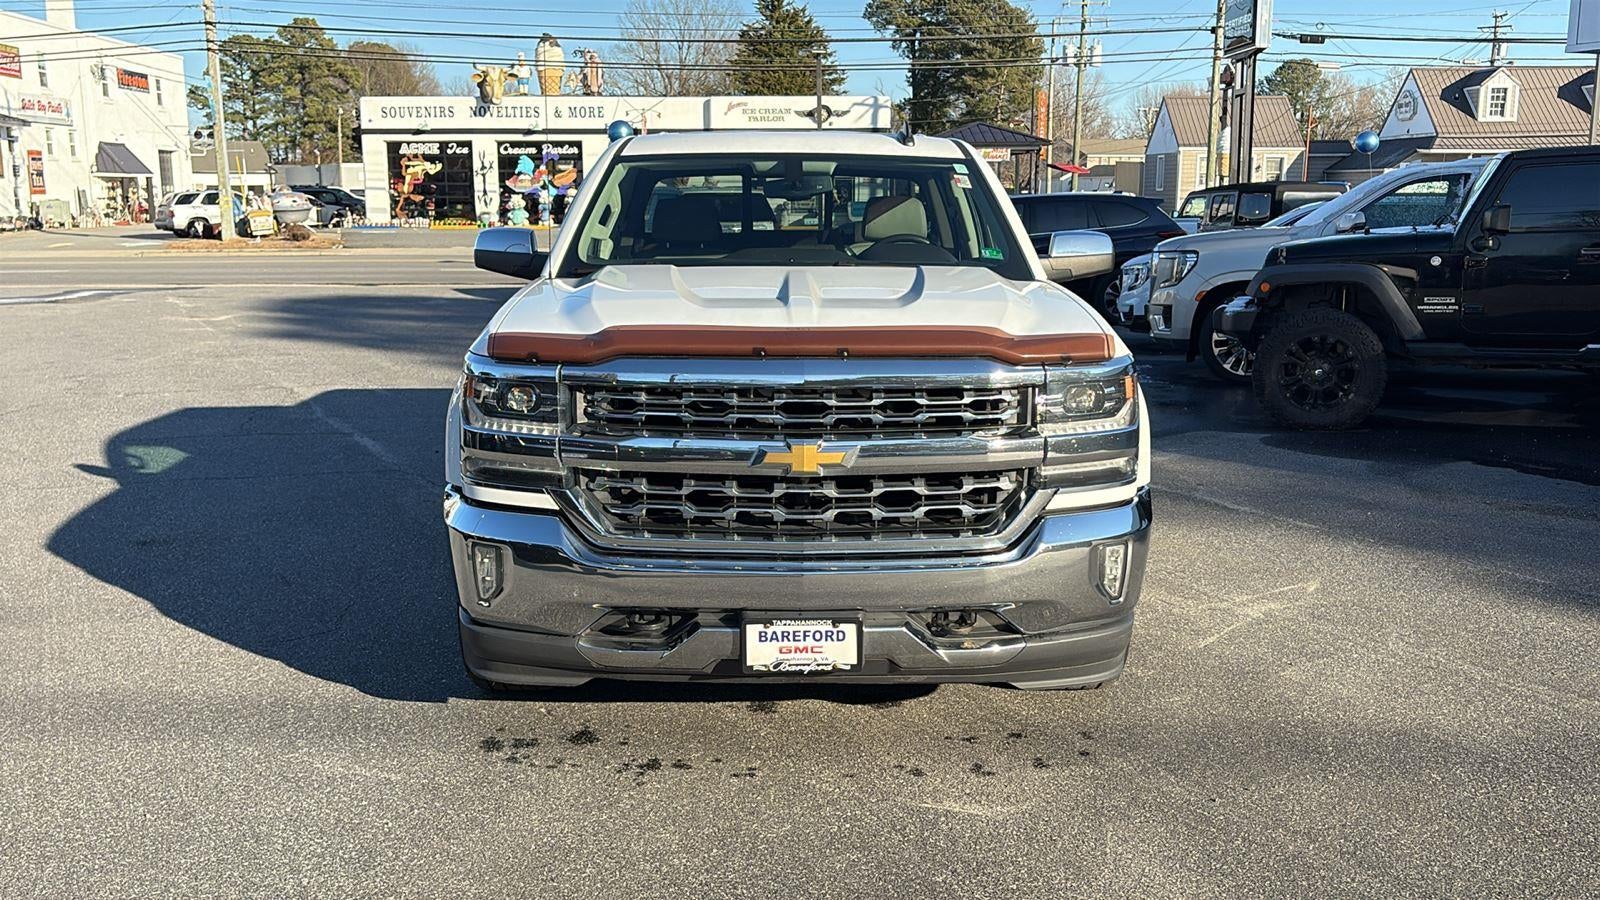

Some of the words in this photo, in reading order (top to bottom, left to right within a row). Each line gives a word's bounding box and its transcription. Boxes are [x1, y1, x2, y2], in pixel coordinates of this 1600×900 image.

[381, 106, 455, 119] SOUVENIRS
[469, 105, 540, 119] NOVELTIES
[553, 106, 563, 118] &
[568, 106, 605, 118] MORE
[399, 143, 440, 155] ACME
[447, 143, 470, 154] Ice
[499, 143, 537, 155] Cream
[542, 143, 579, 155] Parlor
[758, 630, 846, 642] BAREFORD
[778, 645, 823, 654] GMC
